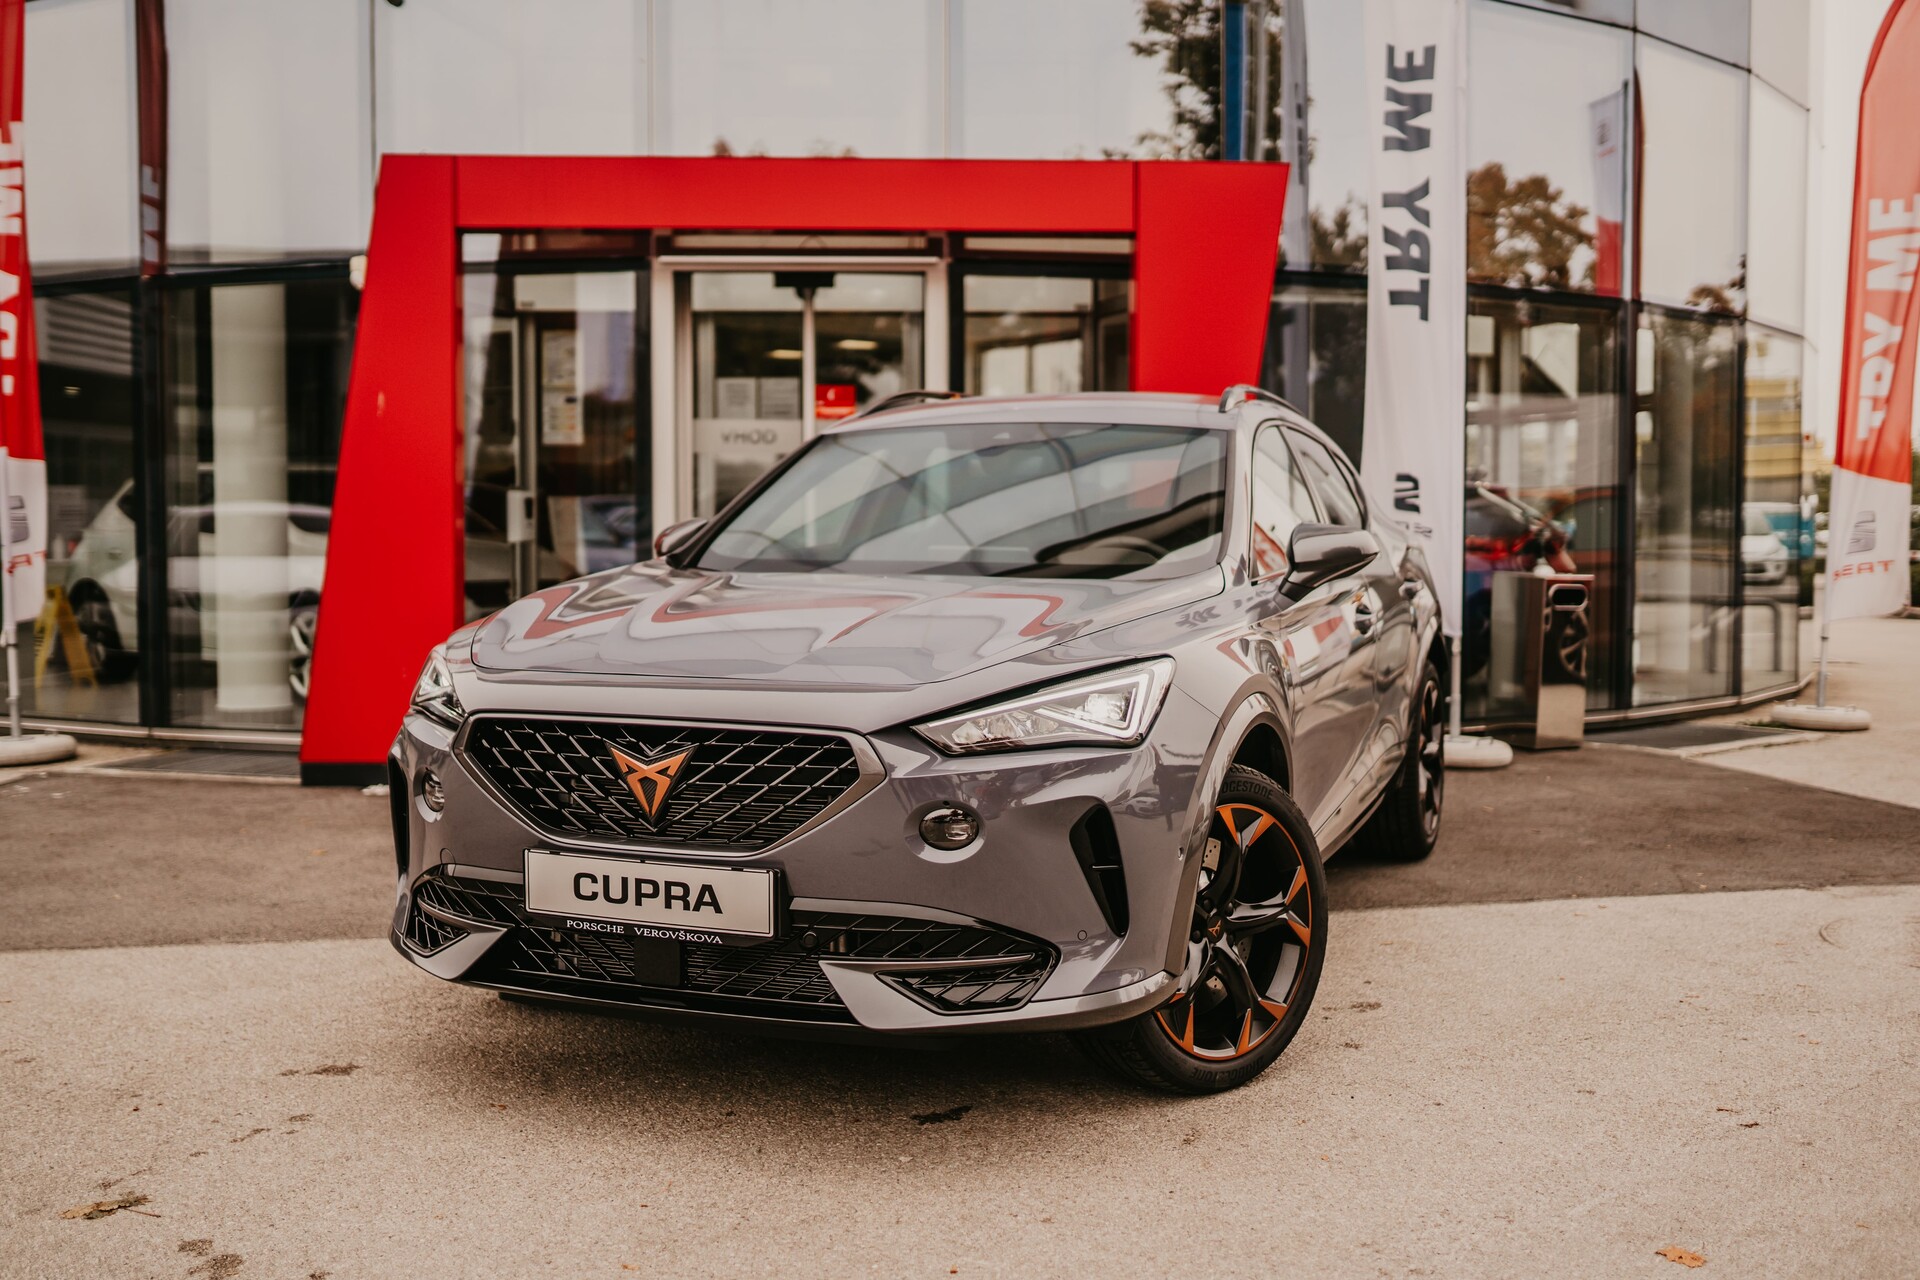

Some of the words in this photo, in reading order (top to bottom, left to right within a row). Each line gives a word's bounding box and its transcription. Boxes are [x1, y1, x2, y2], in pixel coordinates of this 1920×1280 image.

[573, 872, 723, 914] CUPRA
[566, 919, 625, 934] PORSCHE
[634, 927, 723, 944] VEROVŠKOVA
